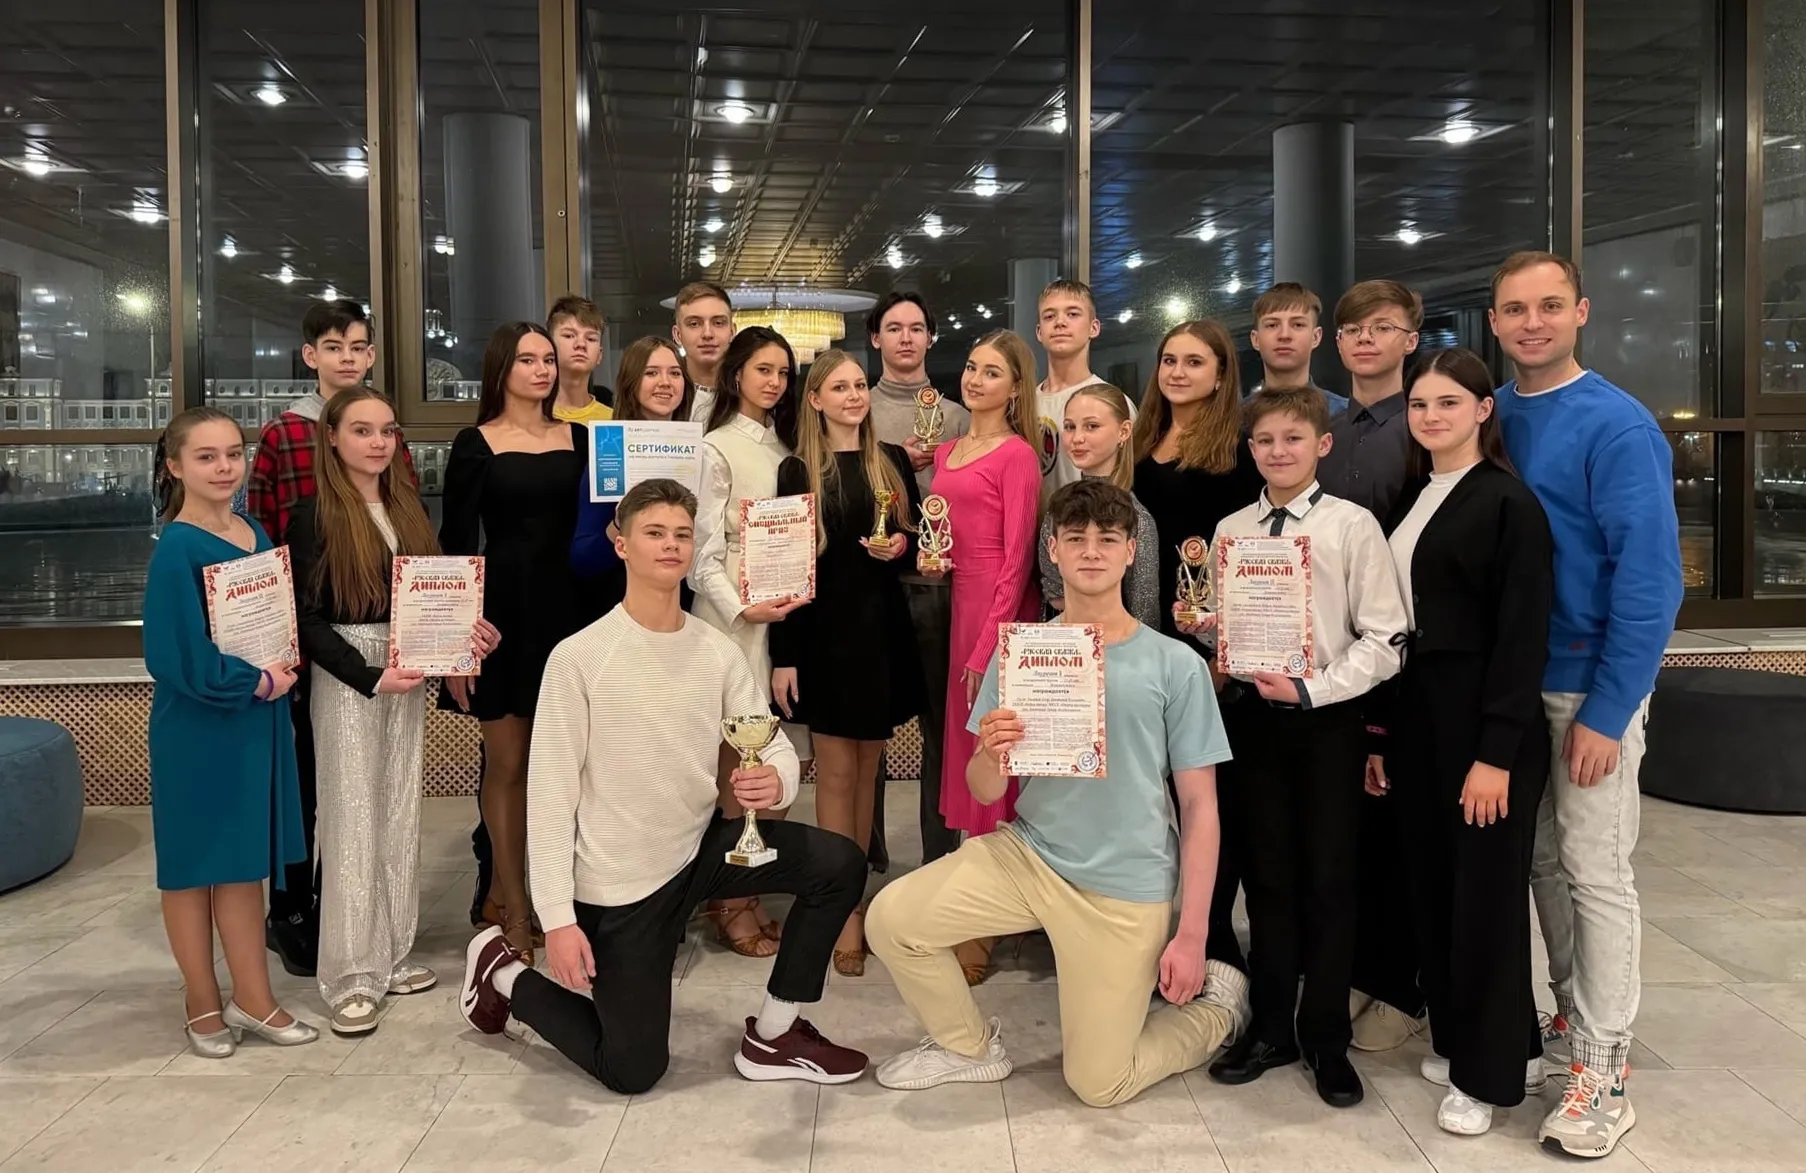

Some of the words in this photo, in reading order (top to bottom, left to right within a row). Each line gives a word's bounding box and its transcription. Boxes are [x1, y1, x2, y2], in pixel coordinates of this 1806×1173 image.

[627, 443, 696, 454] СЕРТИФИКАТ
[1235, 565, 1294, 578] ДИПЛОМ
[225, 576, 278, 601] ДИПЛОМ
[409, 581, 467, 593] ДИПЛОМ
[1018, 655, 1084, 670] ДИПЛОМ
